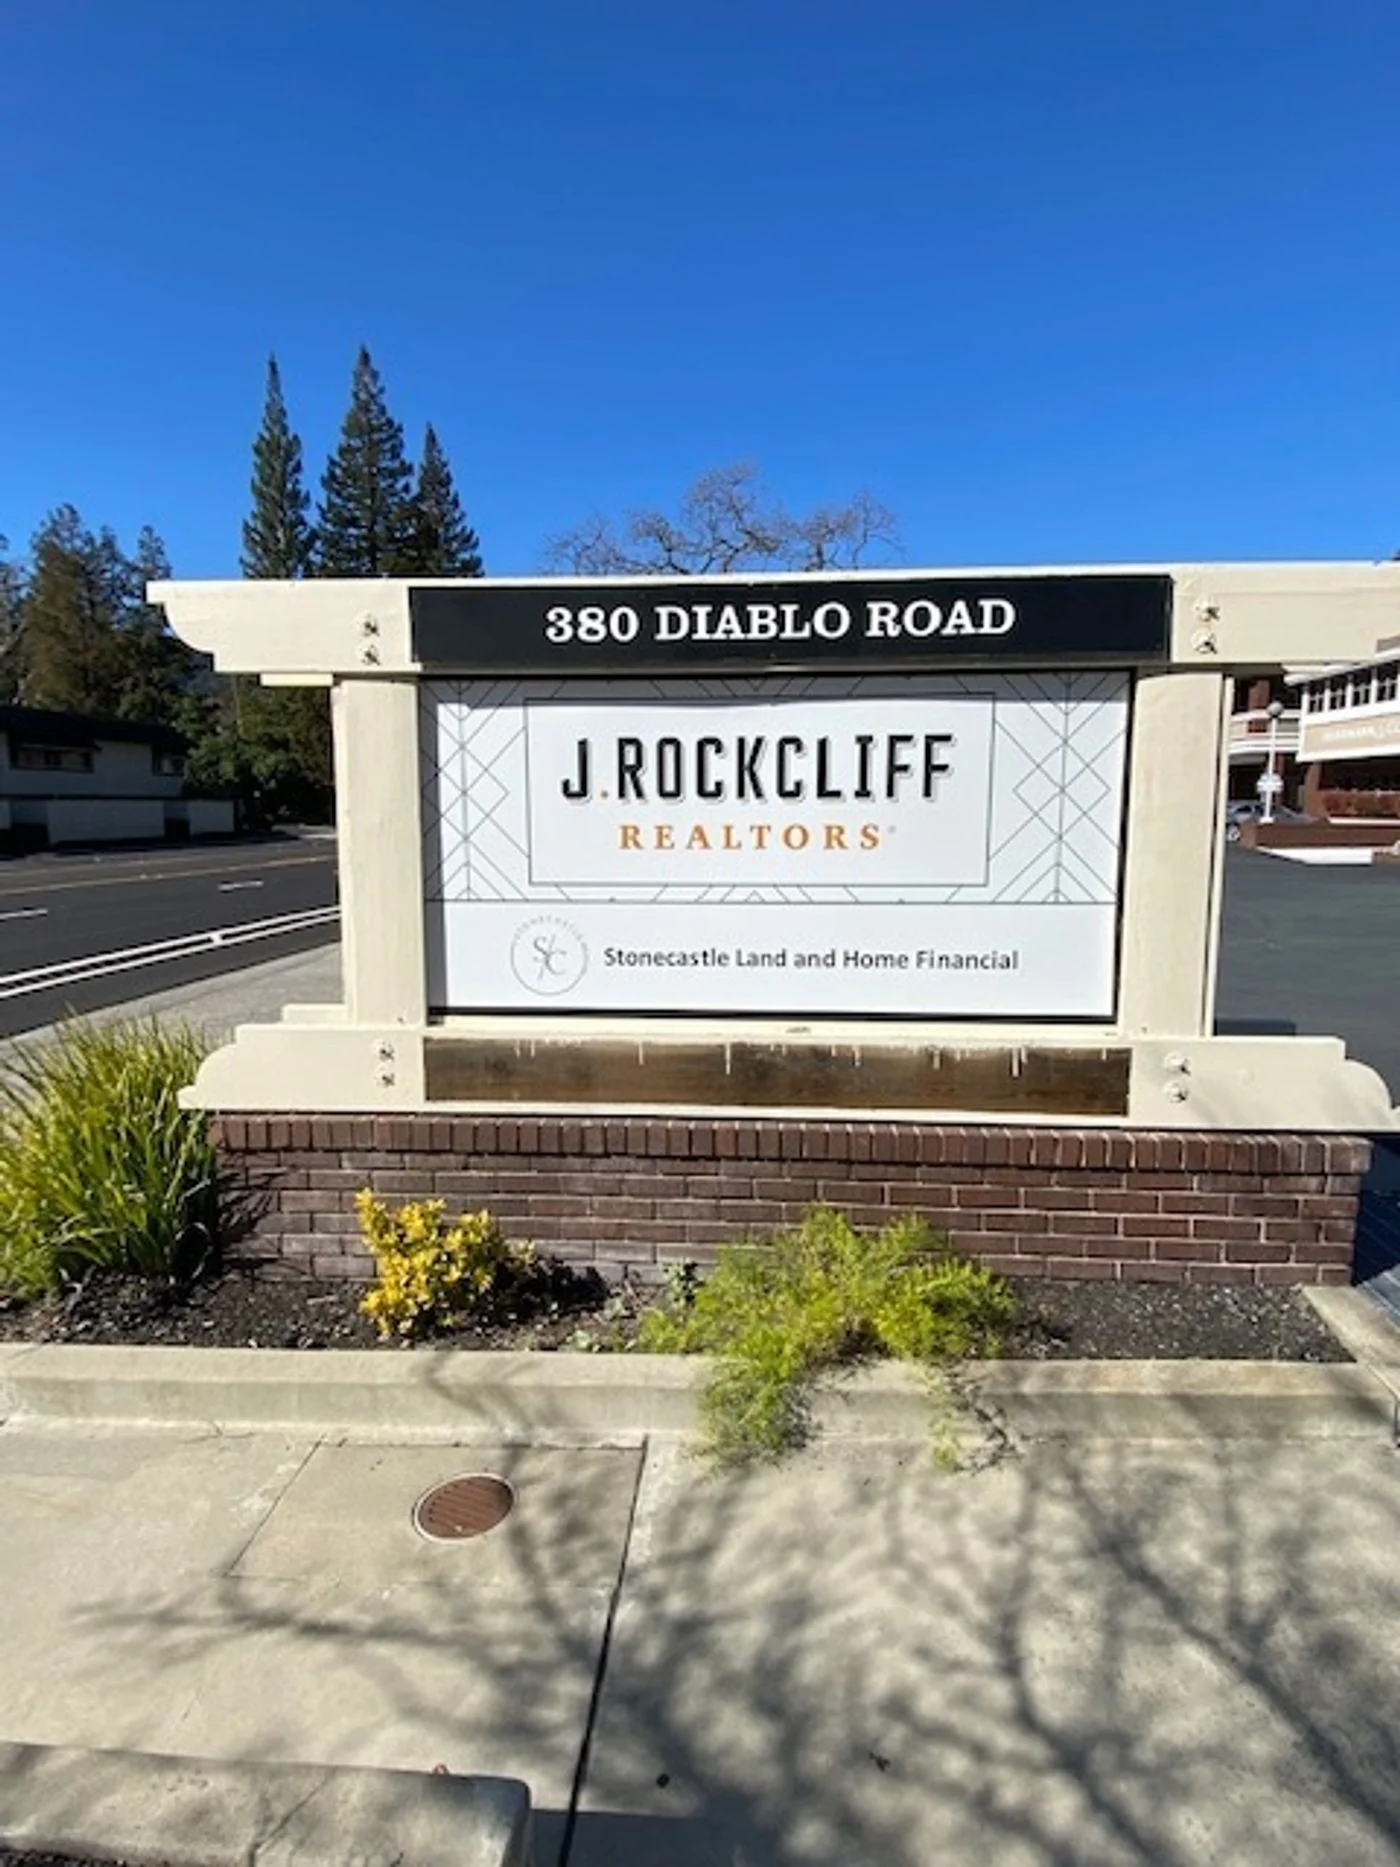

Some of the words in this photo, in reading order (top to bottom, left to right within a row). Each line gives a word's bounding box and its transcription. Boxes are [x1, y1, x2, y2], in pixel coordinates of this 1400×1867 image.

[546, 606, 639, 643] 380
[654, 601, 851, 641] DIABLO
[865, 599, 1015, 637] ROAD
[603, 947, 730, 968] Stonecastle
[735, 948, 787, 968] Land
[793, 949, 836, 969] and
[842, 949, 909, 970] Home
[915, 950, 1019, 970] Financial
